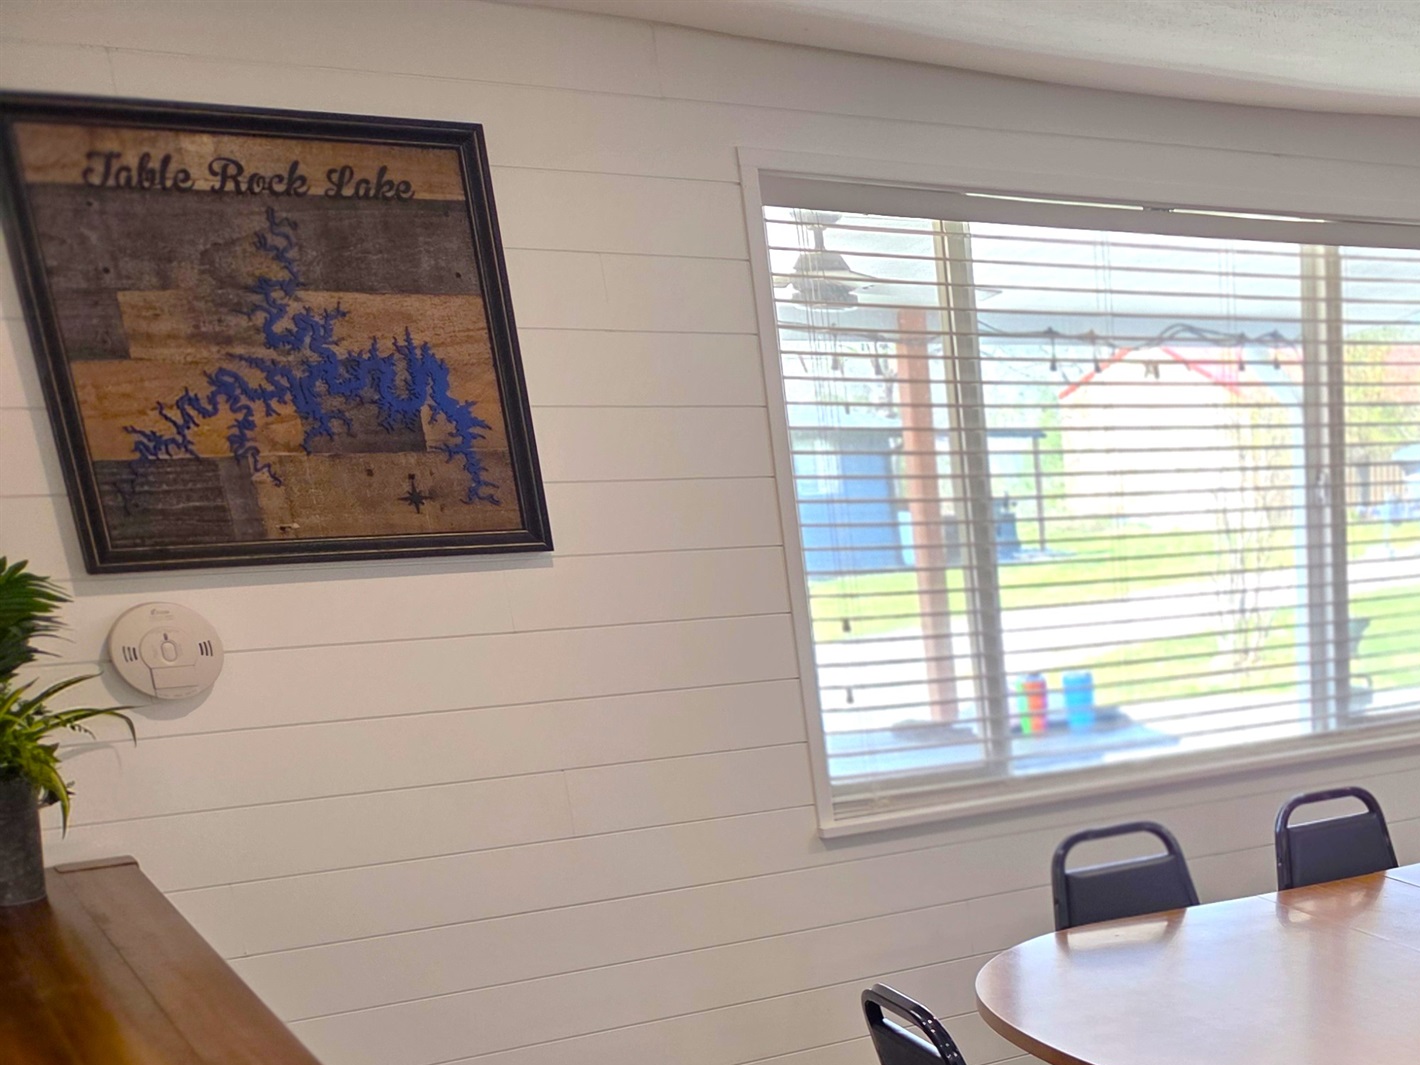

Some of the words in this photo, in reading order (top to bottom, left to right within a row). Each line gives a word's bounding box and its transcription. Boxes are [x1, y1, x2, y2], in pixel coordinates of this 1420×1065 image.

[82, 151, 195, 192] Table
[208, 157, 310, 196] Rock
[325, 165, 415, 201] Lake
